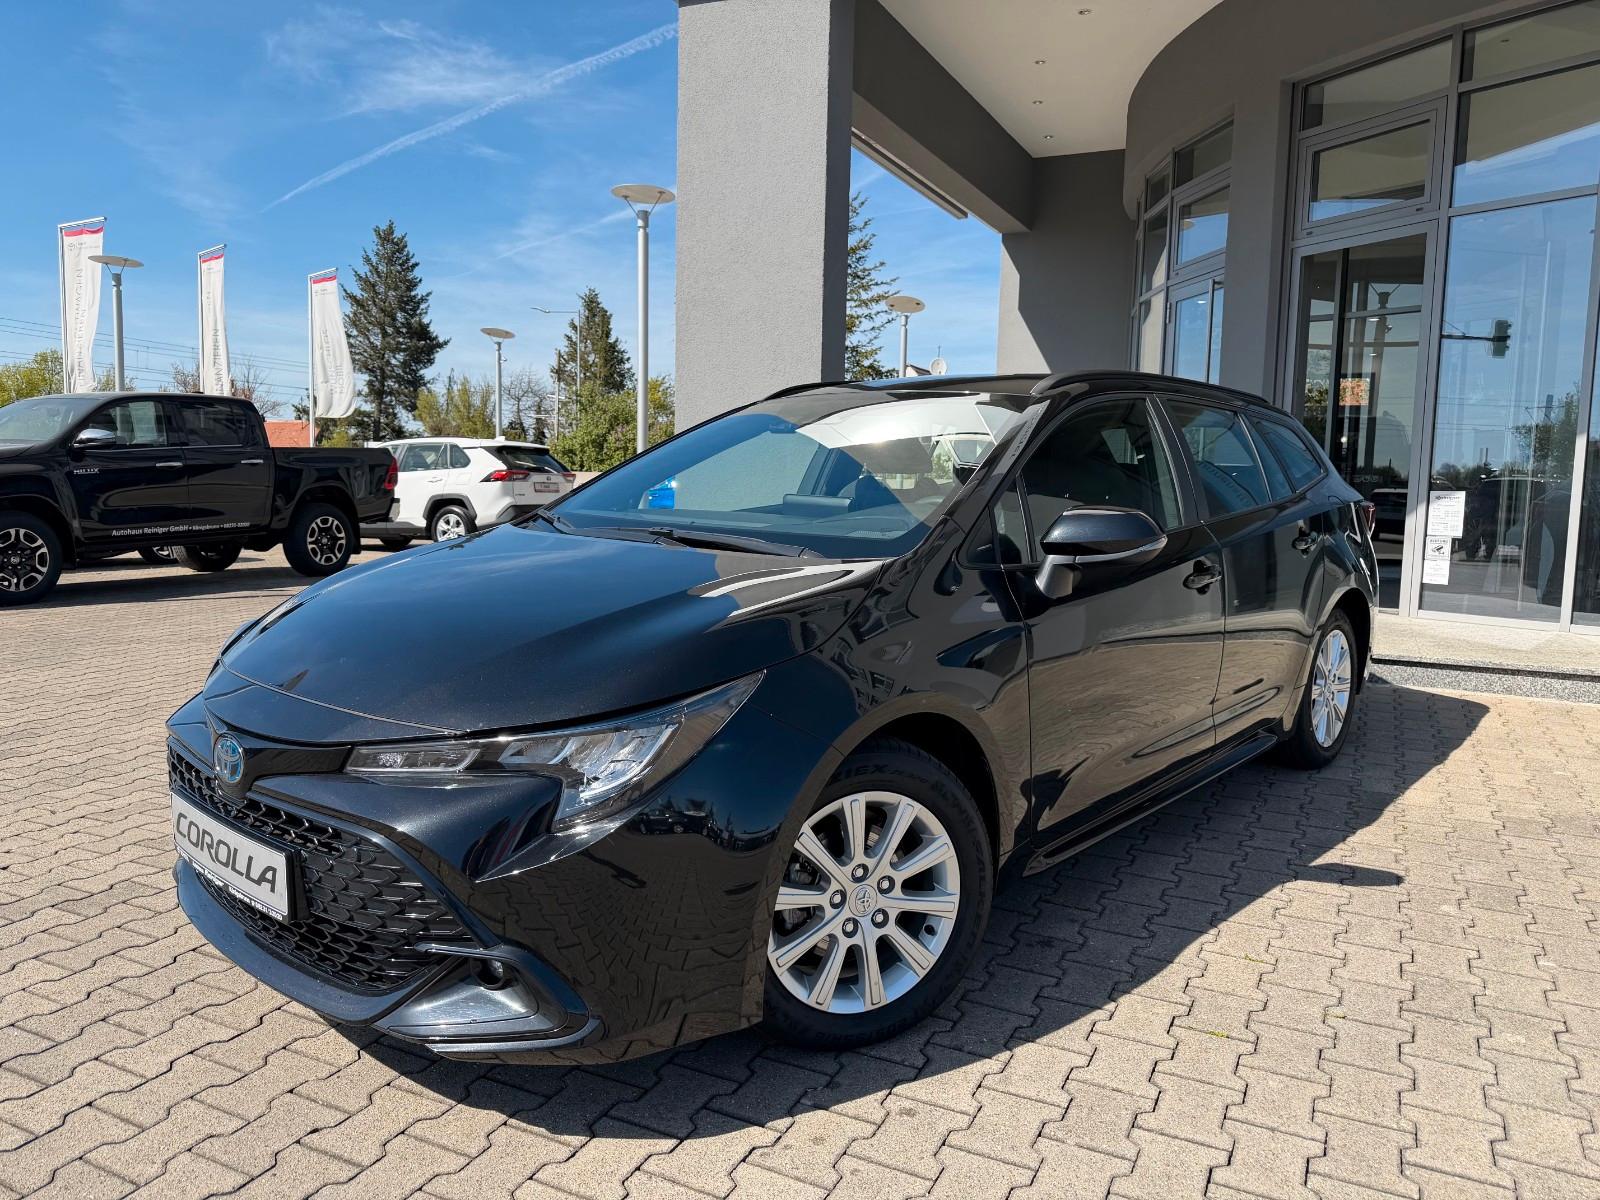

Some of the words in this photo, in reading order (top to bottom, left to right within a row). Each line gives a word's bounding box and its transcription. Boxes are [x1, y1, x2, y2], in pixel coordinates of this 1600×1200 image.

[112, 528, 143, 537] Autohaus
[143, 526, 169, 535] Reiniger
[169, 524, 189, 533] GmbH
[176, 812, 278, 894] COROLLA
